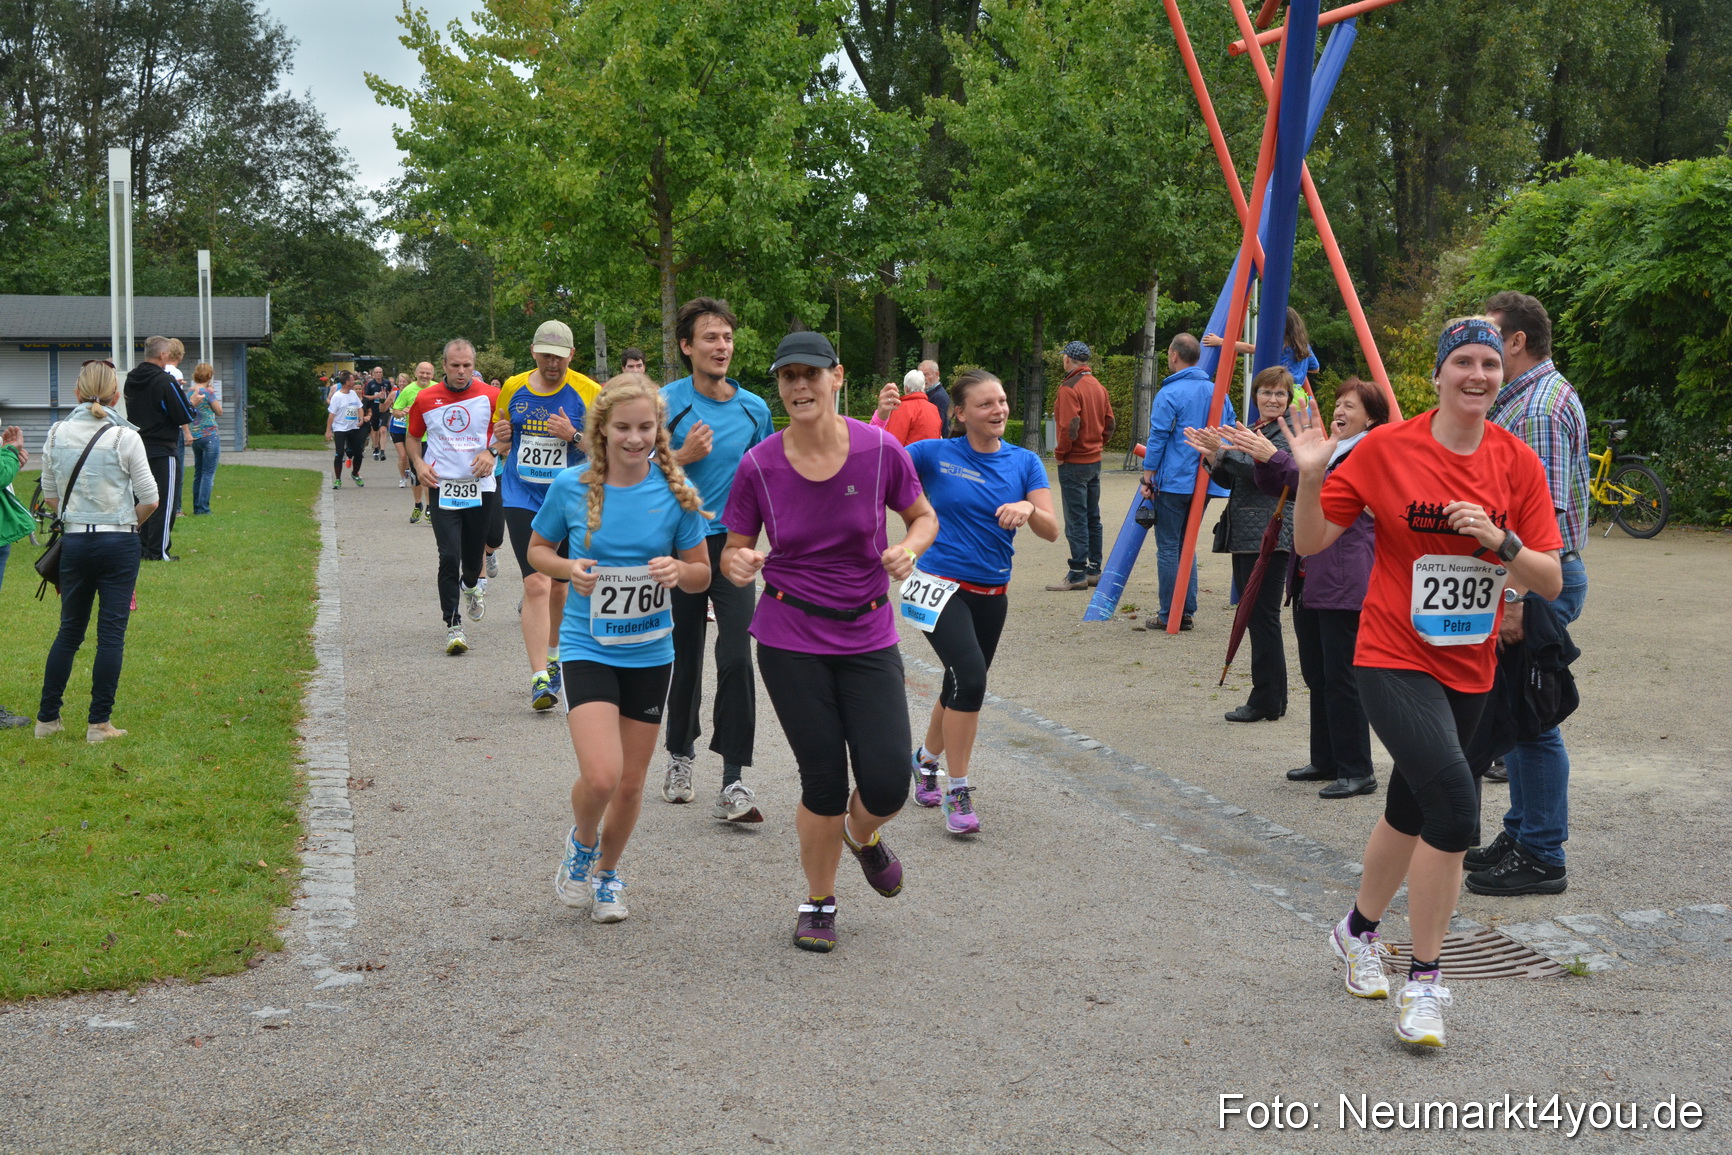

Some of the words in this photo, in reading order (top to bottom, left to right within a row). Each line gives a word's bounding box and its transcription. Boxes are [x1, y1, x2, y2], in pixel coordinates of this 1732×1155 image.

[522, 447, 562, 466] 2872
[530, 468, 552, 477] Robert
[444, 483, 478, 498] 2939
[1412, 516, 1436, 528] RUN
[1415, 563, 1447, 572] PARTL
[1448, 563, 1492, 574] Neumarkt
[597, 574, 623, 582] ARTL
[600, 582, 665, 615] 2760
[902, 579, 946, 607] 2219
[1423, 576, 1494, 610] 2393
[606, 618, 660, 634] Fredericka
[1443, 619, 1471, 632] Petra
